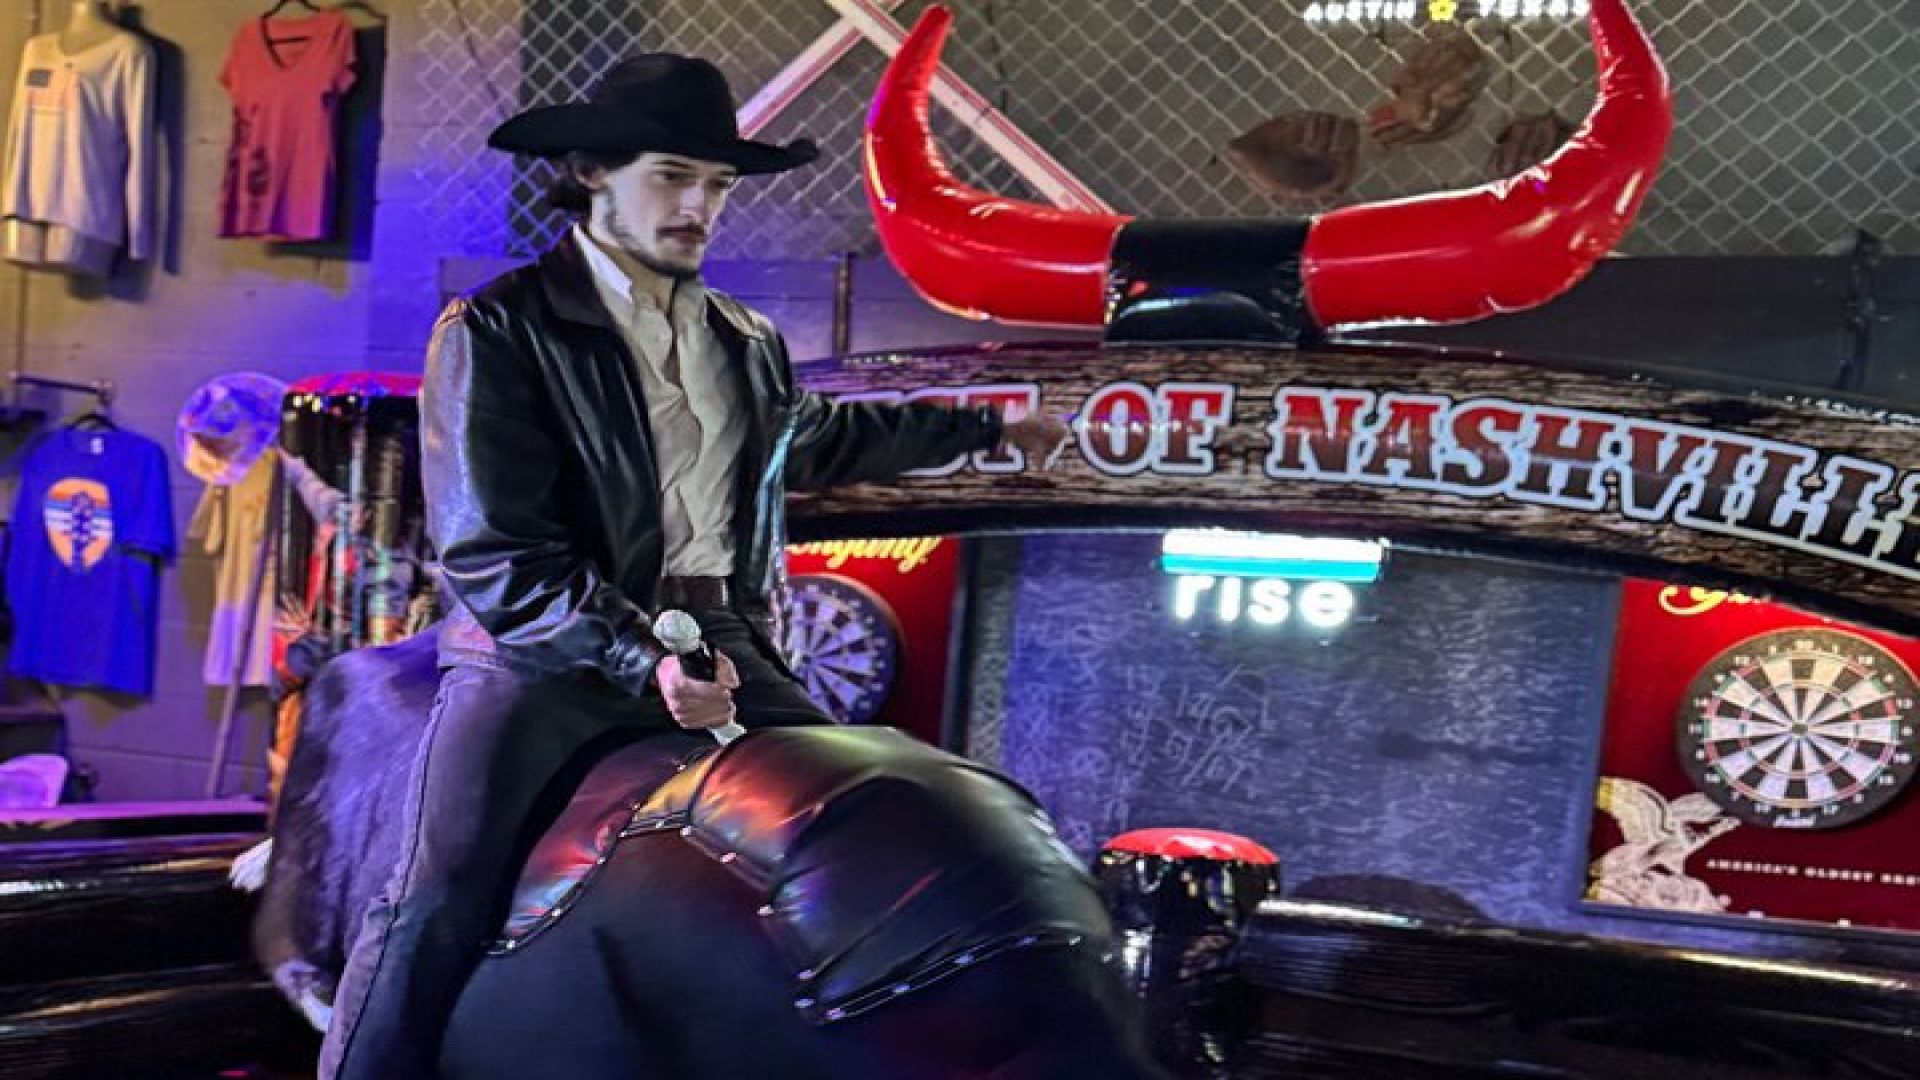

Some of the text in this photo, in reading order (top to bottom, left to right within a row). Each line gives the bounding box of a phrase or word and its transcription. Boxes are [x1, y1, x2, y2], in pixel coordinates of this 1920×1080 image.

[1073, 379, 1235, 475] OF
[1175, 574, 1356, 629] rise
[1879, 873, 1920, 886] BRE
